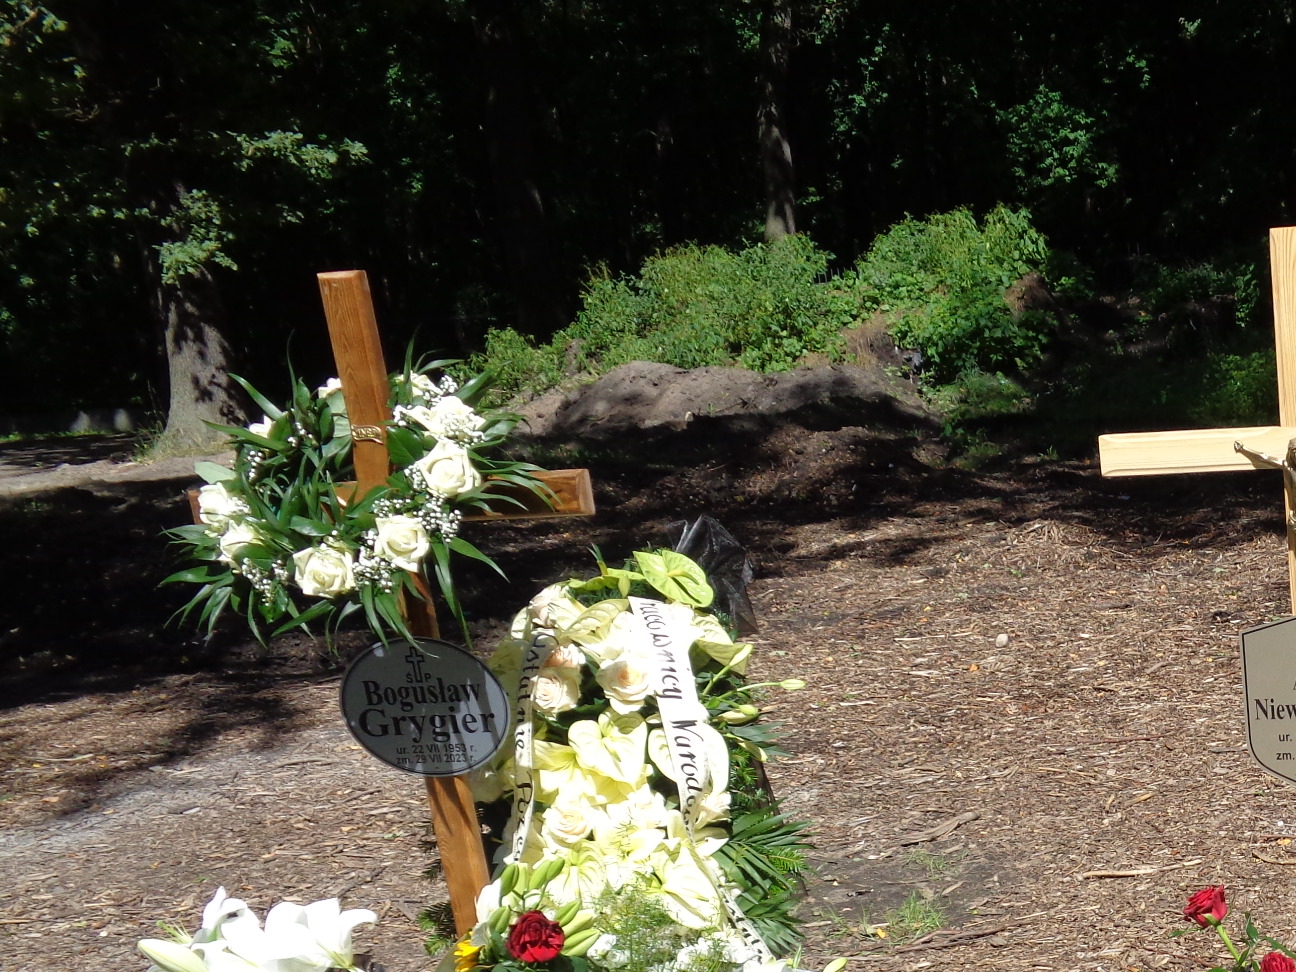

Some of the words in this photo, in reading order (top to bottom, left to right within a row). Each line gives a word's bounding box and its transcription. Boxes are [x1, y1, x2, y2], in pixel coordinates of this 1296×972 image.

[359, 706, 495, 743] Grygier
[1279, 733, 1292, 742] ur.
[397, 746, 409, 755] ur.
[412, 745, 424, 754] 22
[426, 744, 441, 753] VII
[416, 755, 427, 764] 29
[430, 755, 442, 763] VII
[445, 754, 467, 763] 2023
[1276, 752, 1295, 761] zm.
